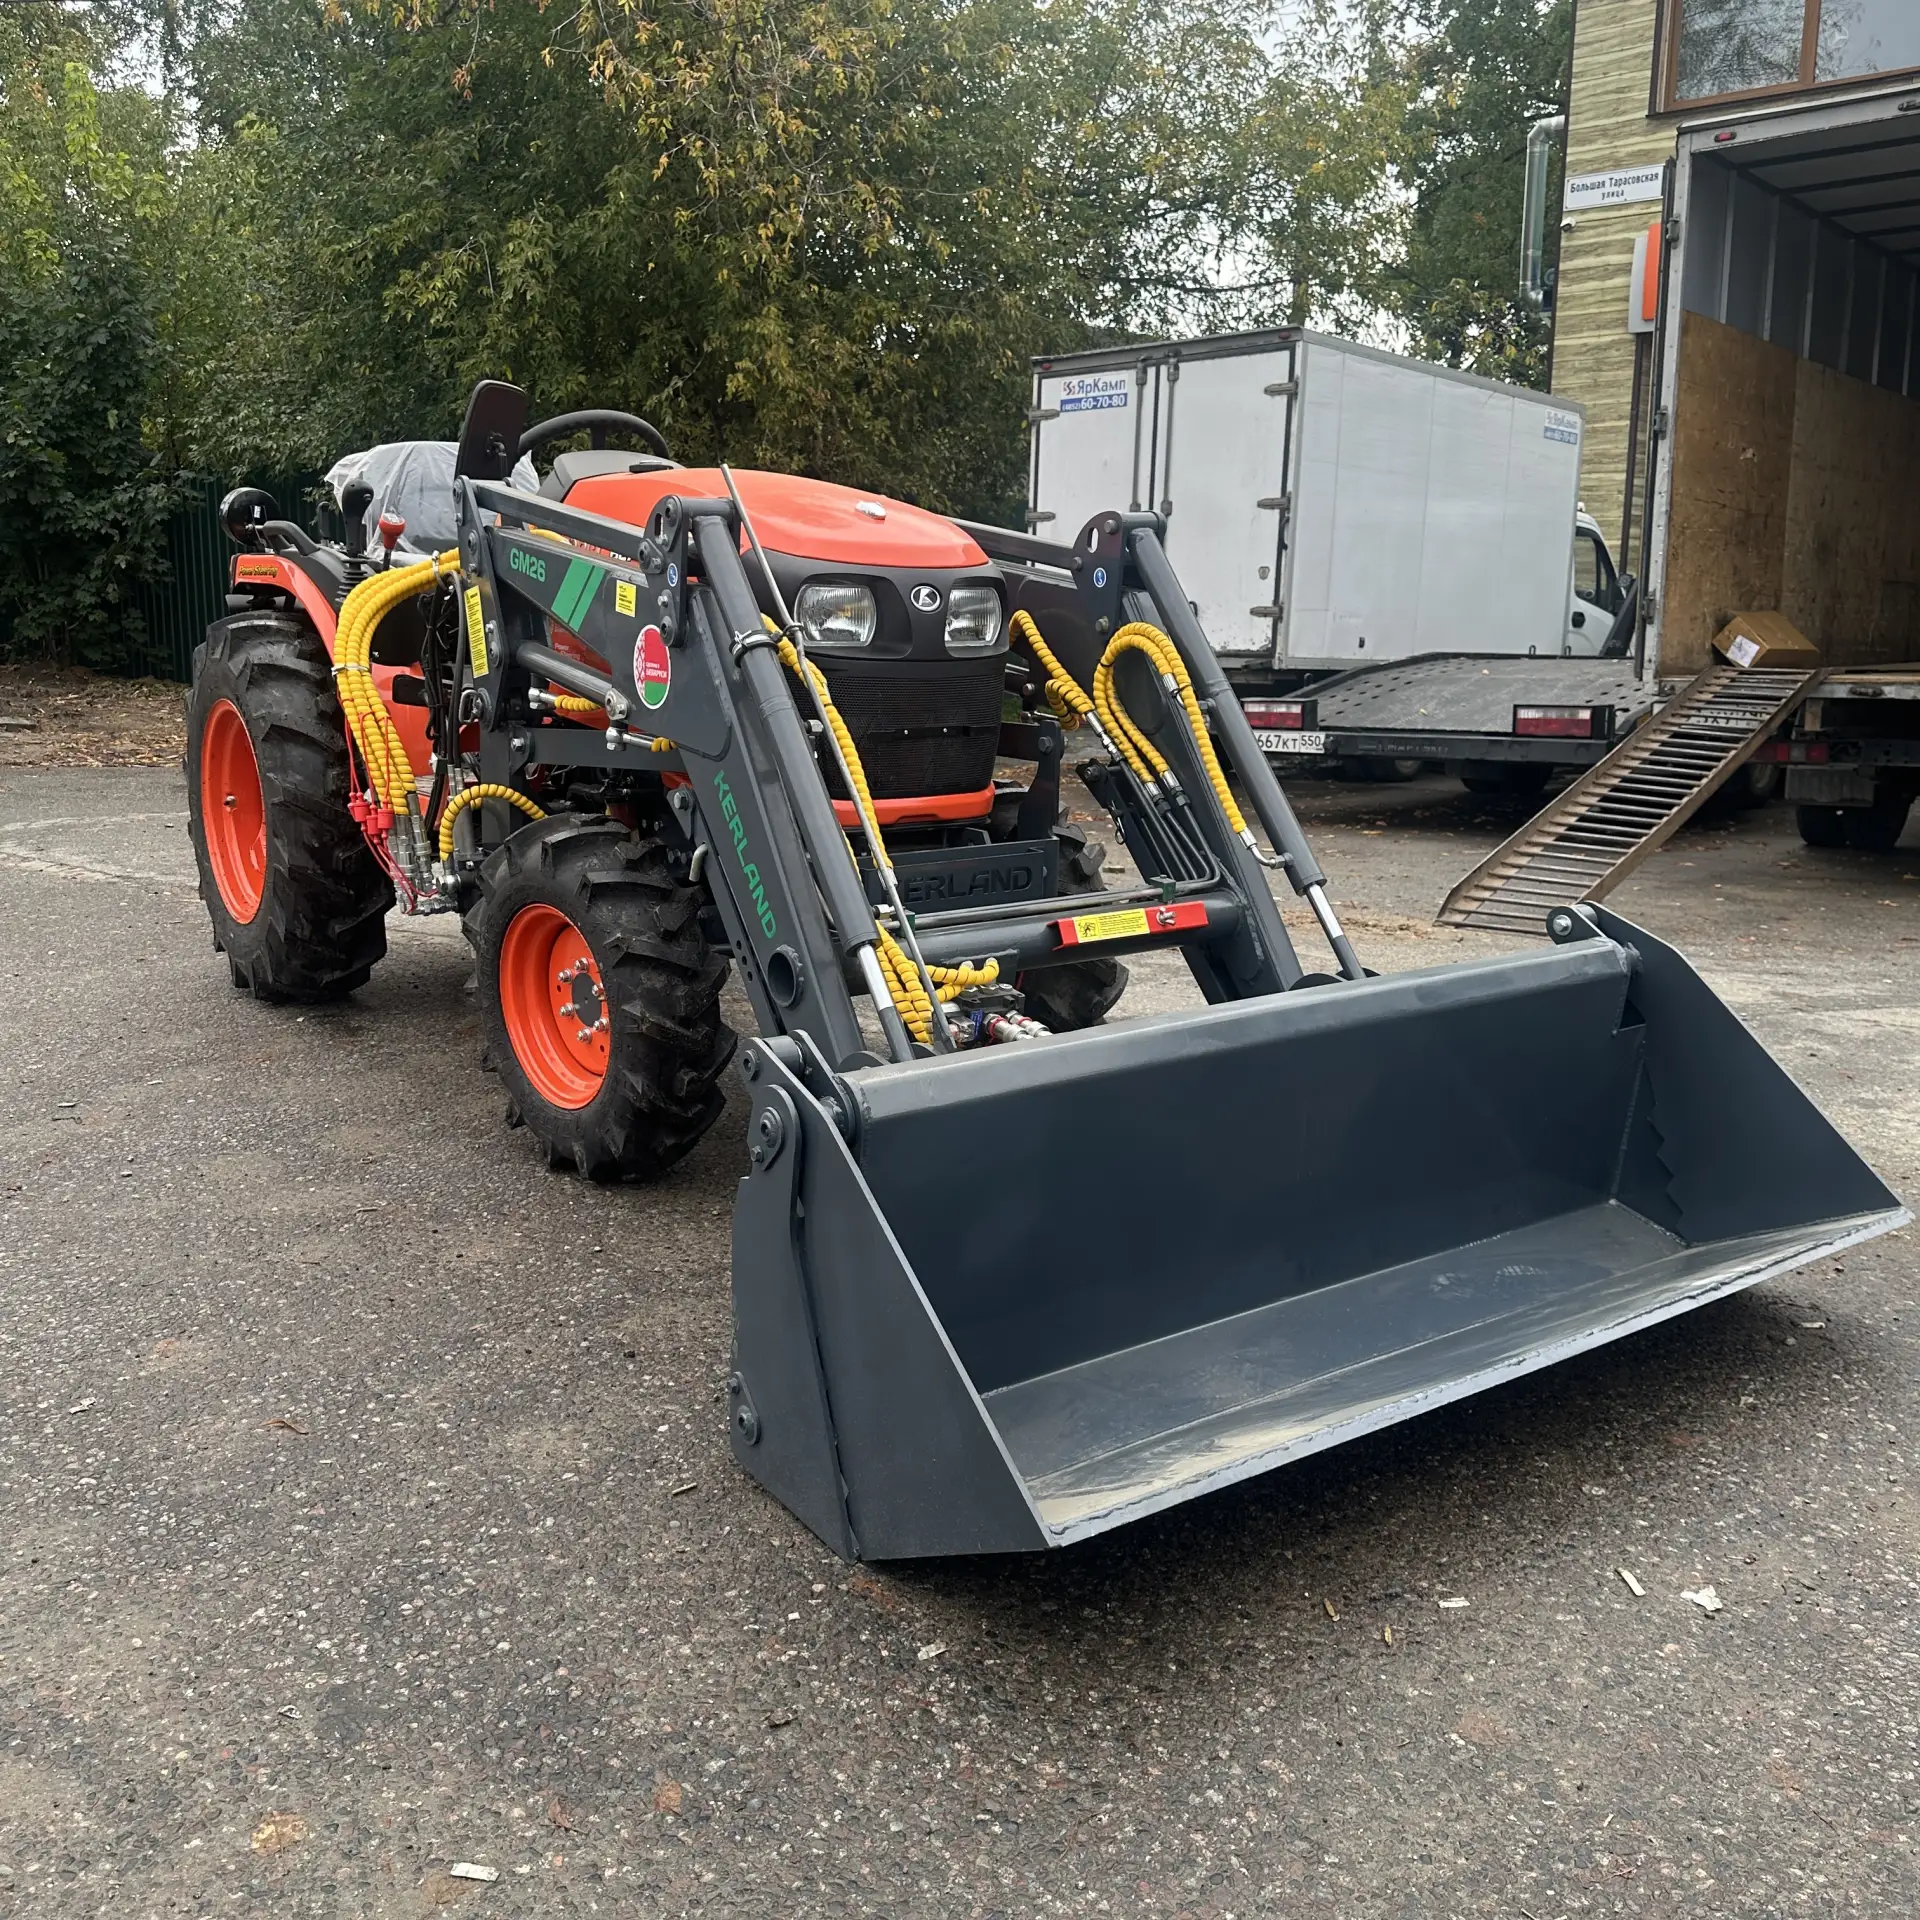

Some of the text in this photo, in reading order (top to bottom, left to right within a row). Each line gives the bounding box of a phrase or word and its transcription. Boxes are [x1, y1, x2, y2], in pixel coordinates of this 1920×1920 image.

[1570, 172, 1659, 193] Большая Тарасовская
[1601, 189, 1625, 200] улица
[1077, 378, 1126, 396] ЯрКамп
[1080, 395, 1125, 410] 60-70-80
[510, 548, 546, 582] GM26
[1301, 735, 1321, 747] 550
[714, 770, 777, 939] KERLAND
[882, 866, 1033, 904] ERLAND
